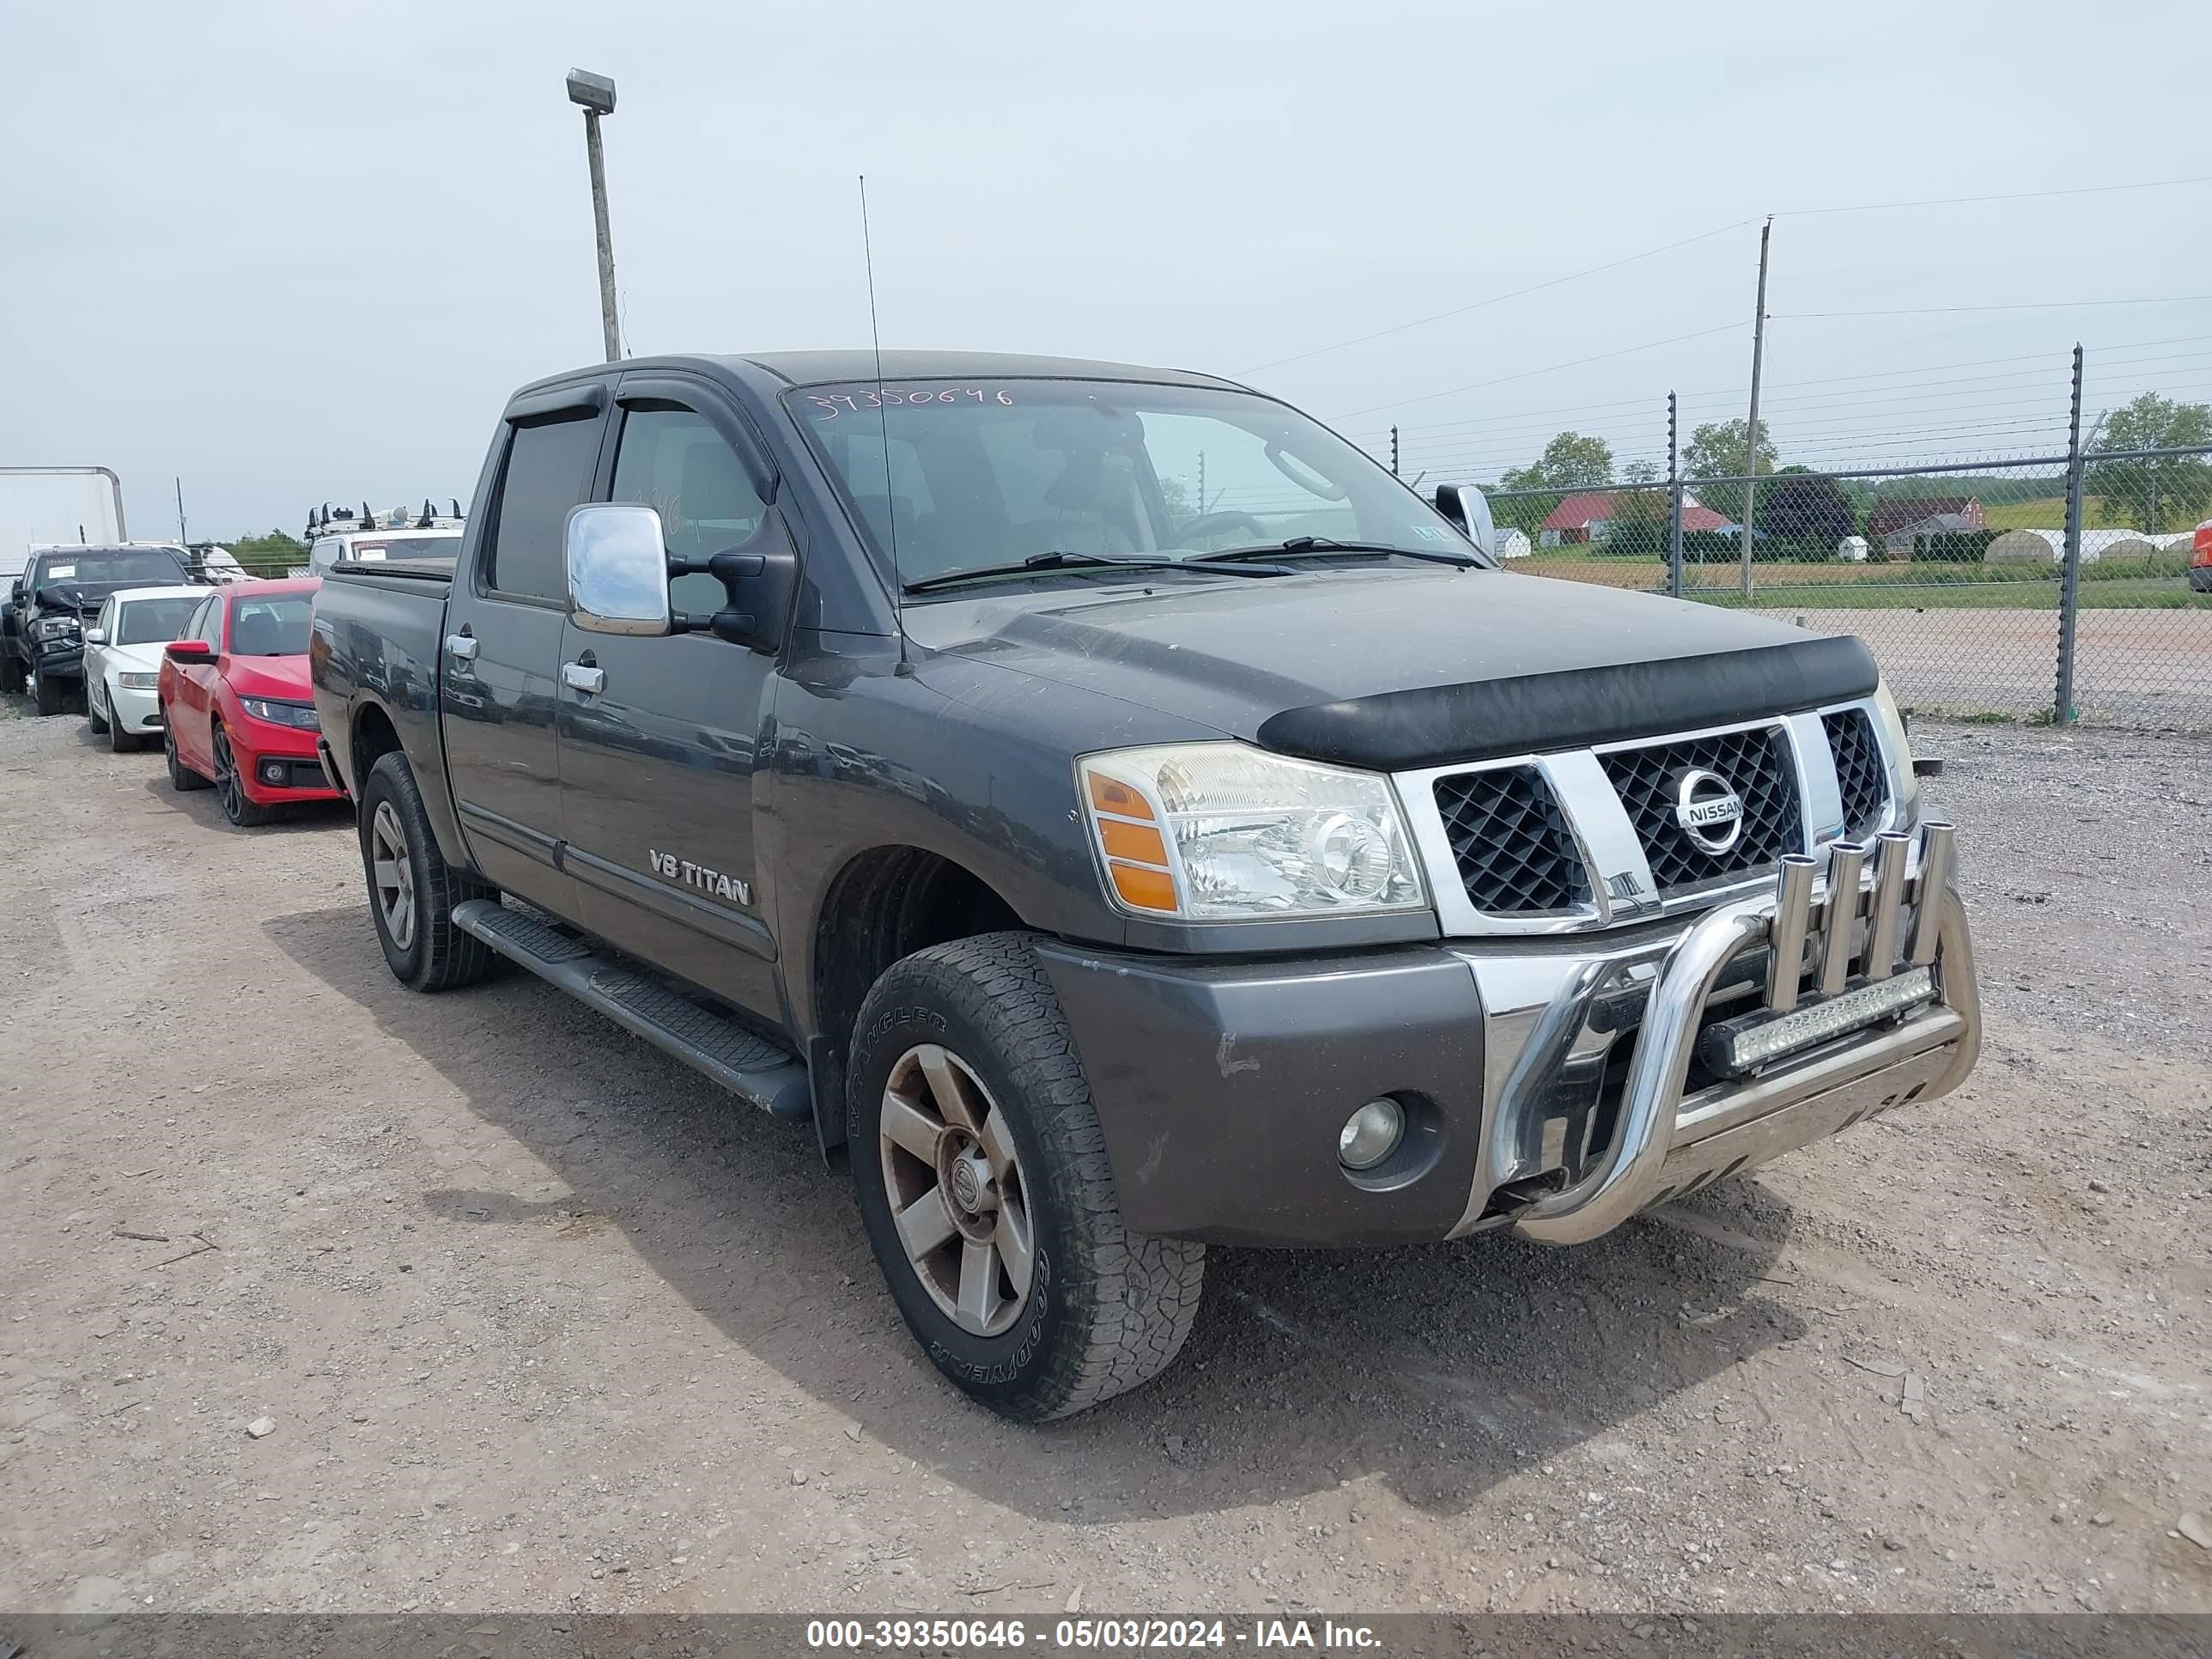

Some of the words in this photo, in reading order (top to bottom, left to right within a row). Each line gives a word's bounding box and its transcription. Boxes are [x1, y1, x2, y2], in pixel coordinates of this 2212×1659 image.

[807, 387, 1013, 421] 39350646
[1688, 800, 1742, 823] NISSAN
[649, 848, 679, 878] V8
[681, 860, 750, 906] TITAN
[850, 1006, 948, 1138] WRANGLER
[930, 1247, 1052, 1385] GOODYEAR
